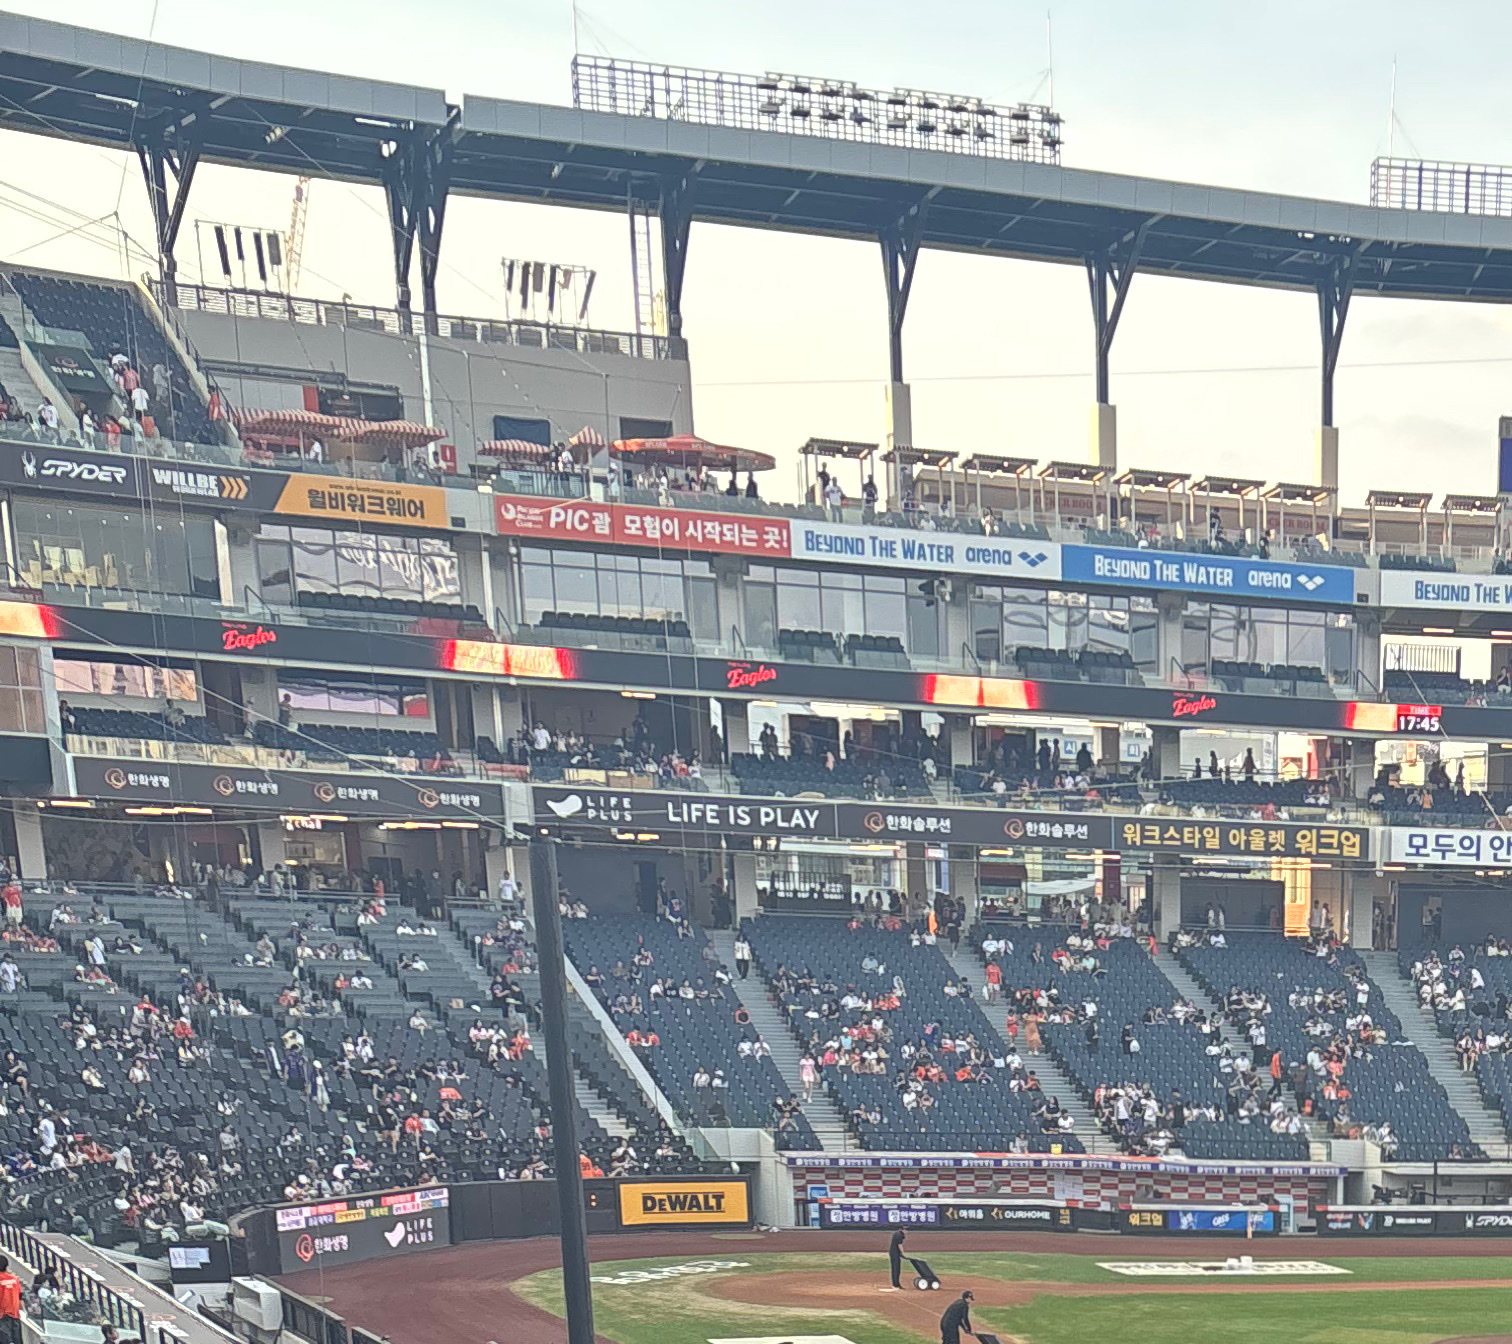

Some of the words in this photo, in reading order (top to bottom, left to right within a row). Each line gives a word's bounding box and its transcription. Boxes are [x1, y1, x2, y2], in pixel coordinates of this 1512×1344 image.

[41, 459, 127, 484] SPYDER
[152, 468, 219, 489] WILLBE
[307, 488, 426, 520] 윌비워크웨어
[623, 514, 680, 541] 모험이
[684, 519, 759, 546] 시작되는
[762, 526, 789, 549] 곳!
[869, 536, 897, 559] THE
[901, 538, 954, 563] WATER
[966, 547, 1012, 565] arena
[1154, 559, 1180, 582] THE
[1184, 562, 1233, 587] WATER
[1248, 568, 1292, 589] arena
[1474, 583, 1500, 604] THE
[1399, 715, 1440, 731] 17:45
[127, 773, 170, 788] 한화생명
[235, 779, 279, 795] 한화생명
[336, 786, 379, 801] 한화생명
[439, 792, 480, 807] 한화생명
[587, 796, 632, 809] LIFE
[587, 808, 633, 822] PLUS
[667, 801, 719, 825] LIFE
[728, 806, 751, 826] IS
[760, 807, 820, 830] PLAY
[886, 814, 952, 833] 한화솔루션
[1025, 821, 1088, 840] 한화솔루션
[1122, 823, 1221, 850] 워크스타일
[1228, 827, 1286, 852] 아울렛
[1295, 829, 1361, 858] 워크업
[1404, 833, 1482, 862] 모두의
[406, 1217, 433, 1232] LIFE
[407, 1231, 434, 1245] PLUS
